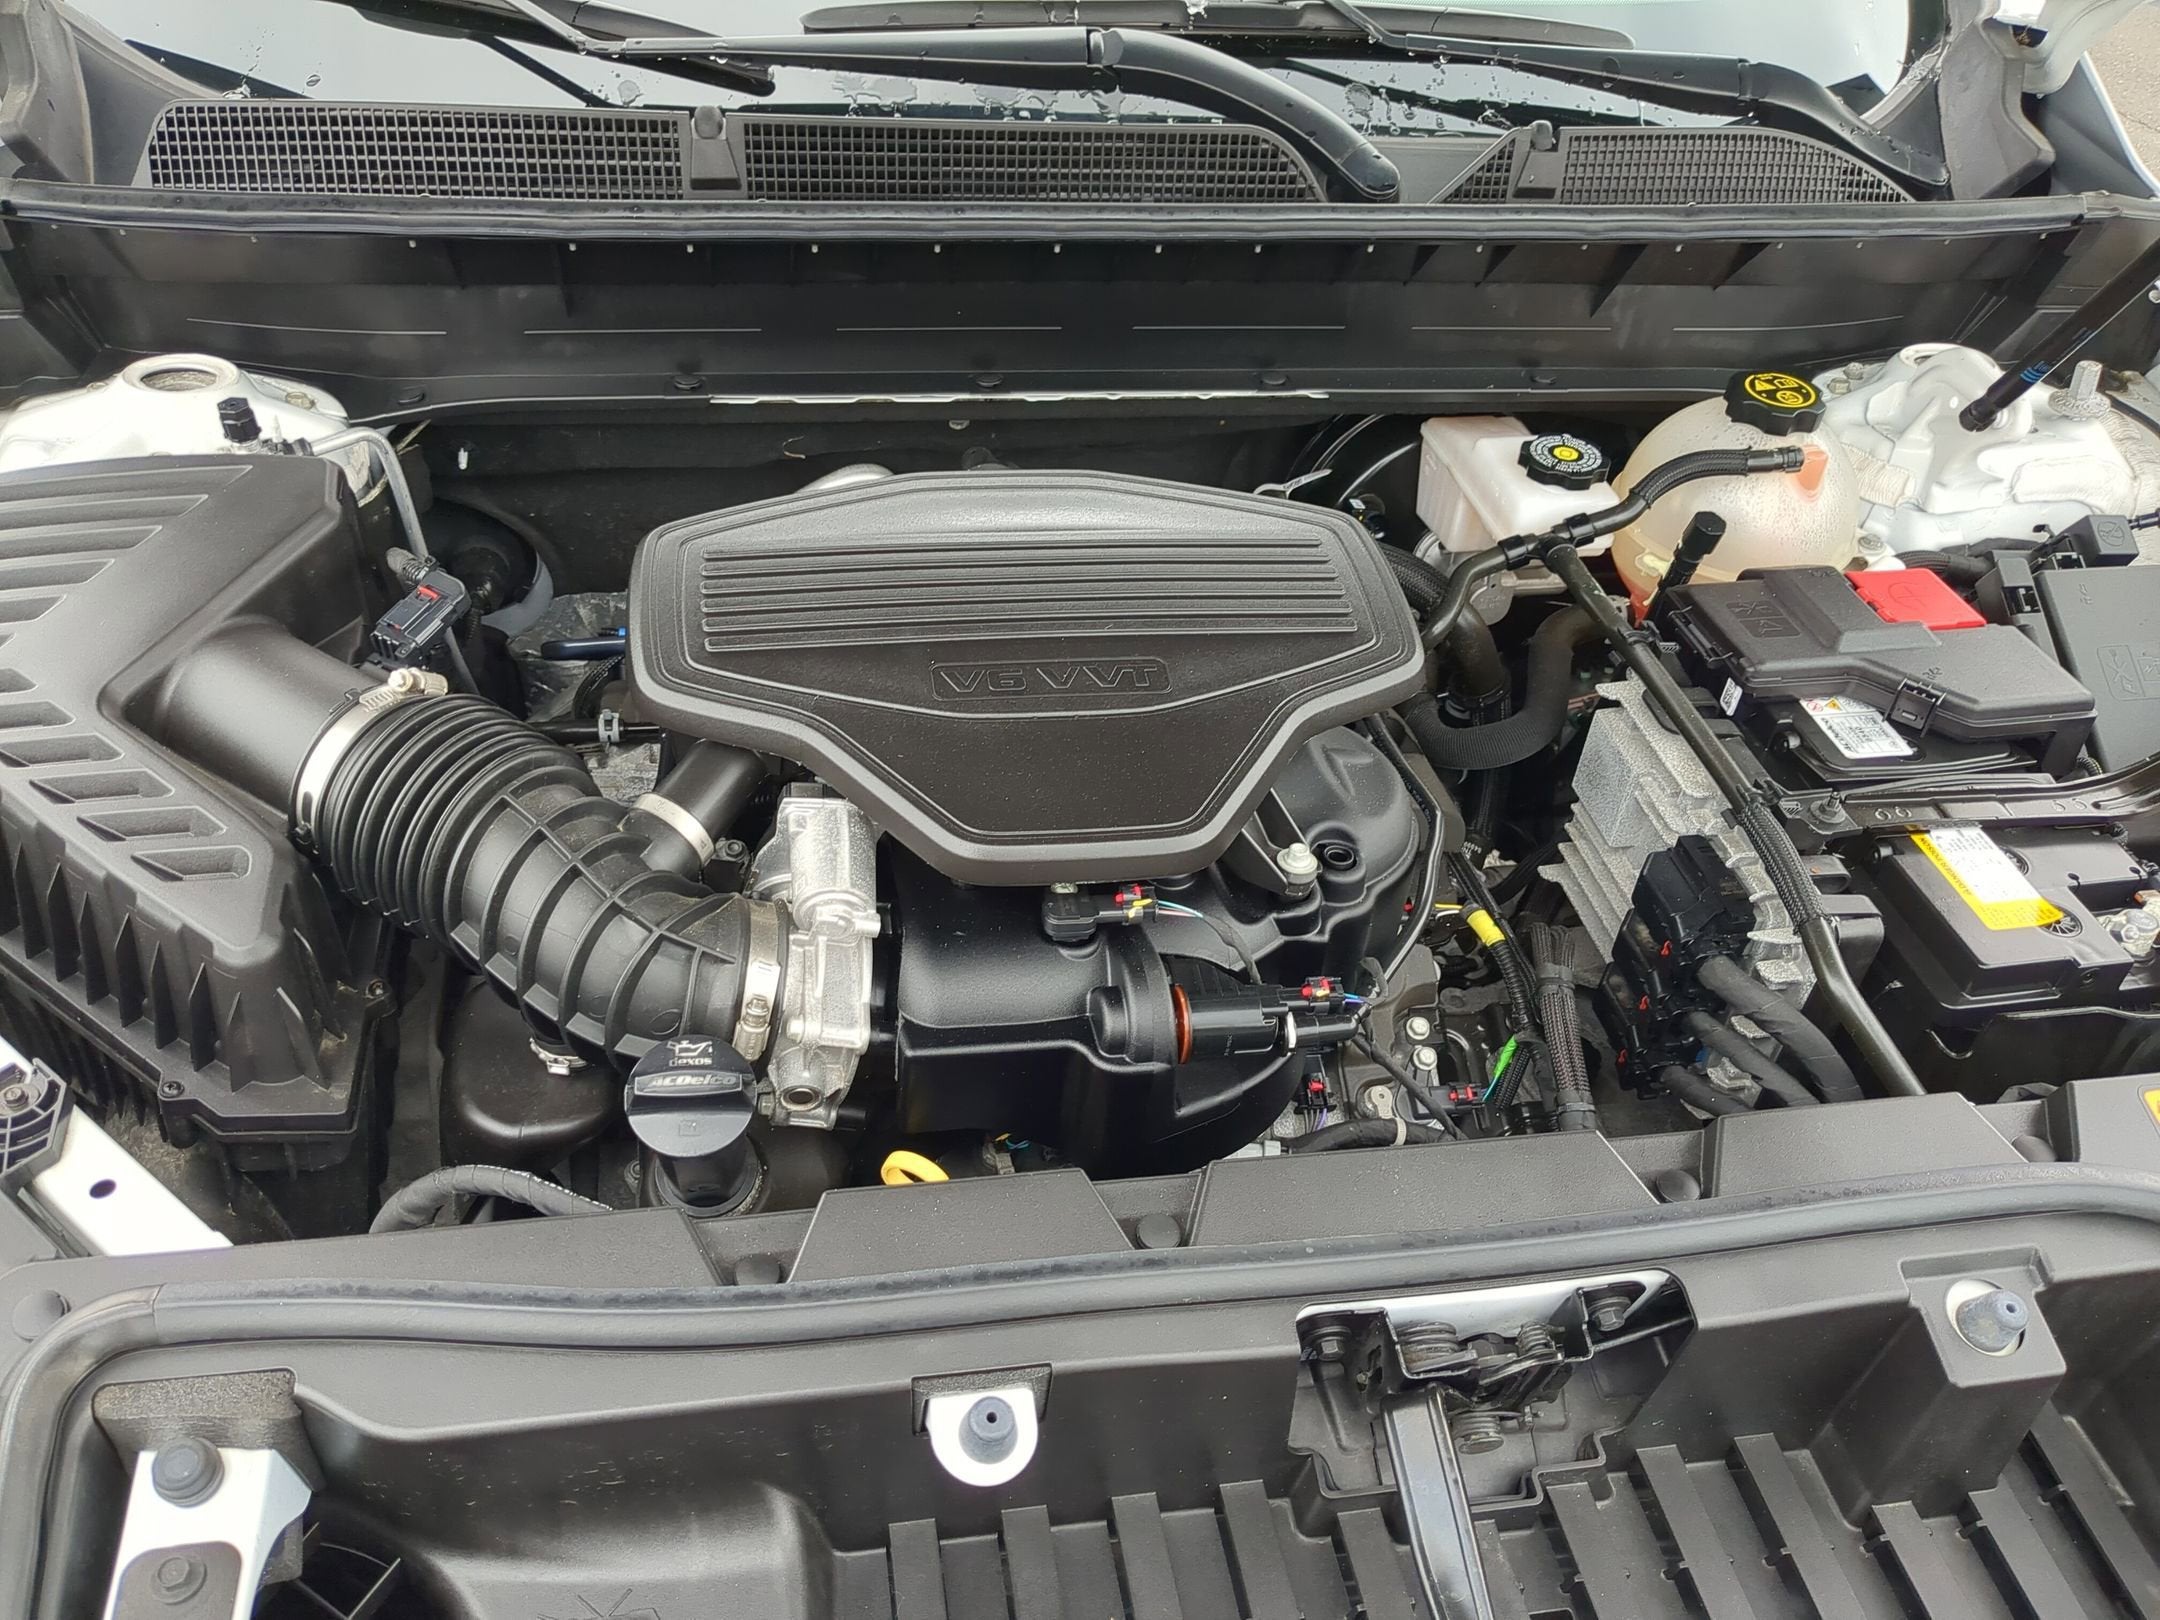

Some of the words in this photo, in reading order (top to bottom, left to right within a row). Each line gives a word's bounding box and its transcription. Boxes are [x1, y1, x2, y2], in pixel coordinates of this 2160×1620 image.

[940, 668, 1027, 693] V6
[1036, 664, 1158, 689] VVT
[669, 1057, 712, 1067] dexos
[648, 1074, 737, 1087] ACDelco
